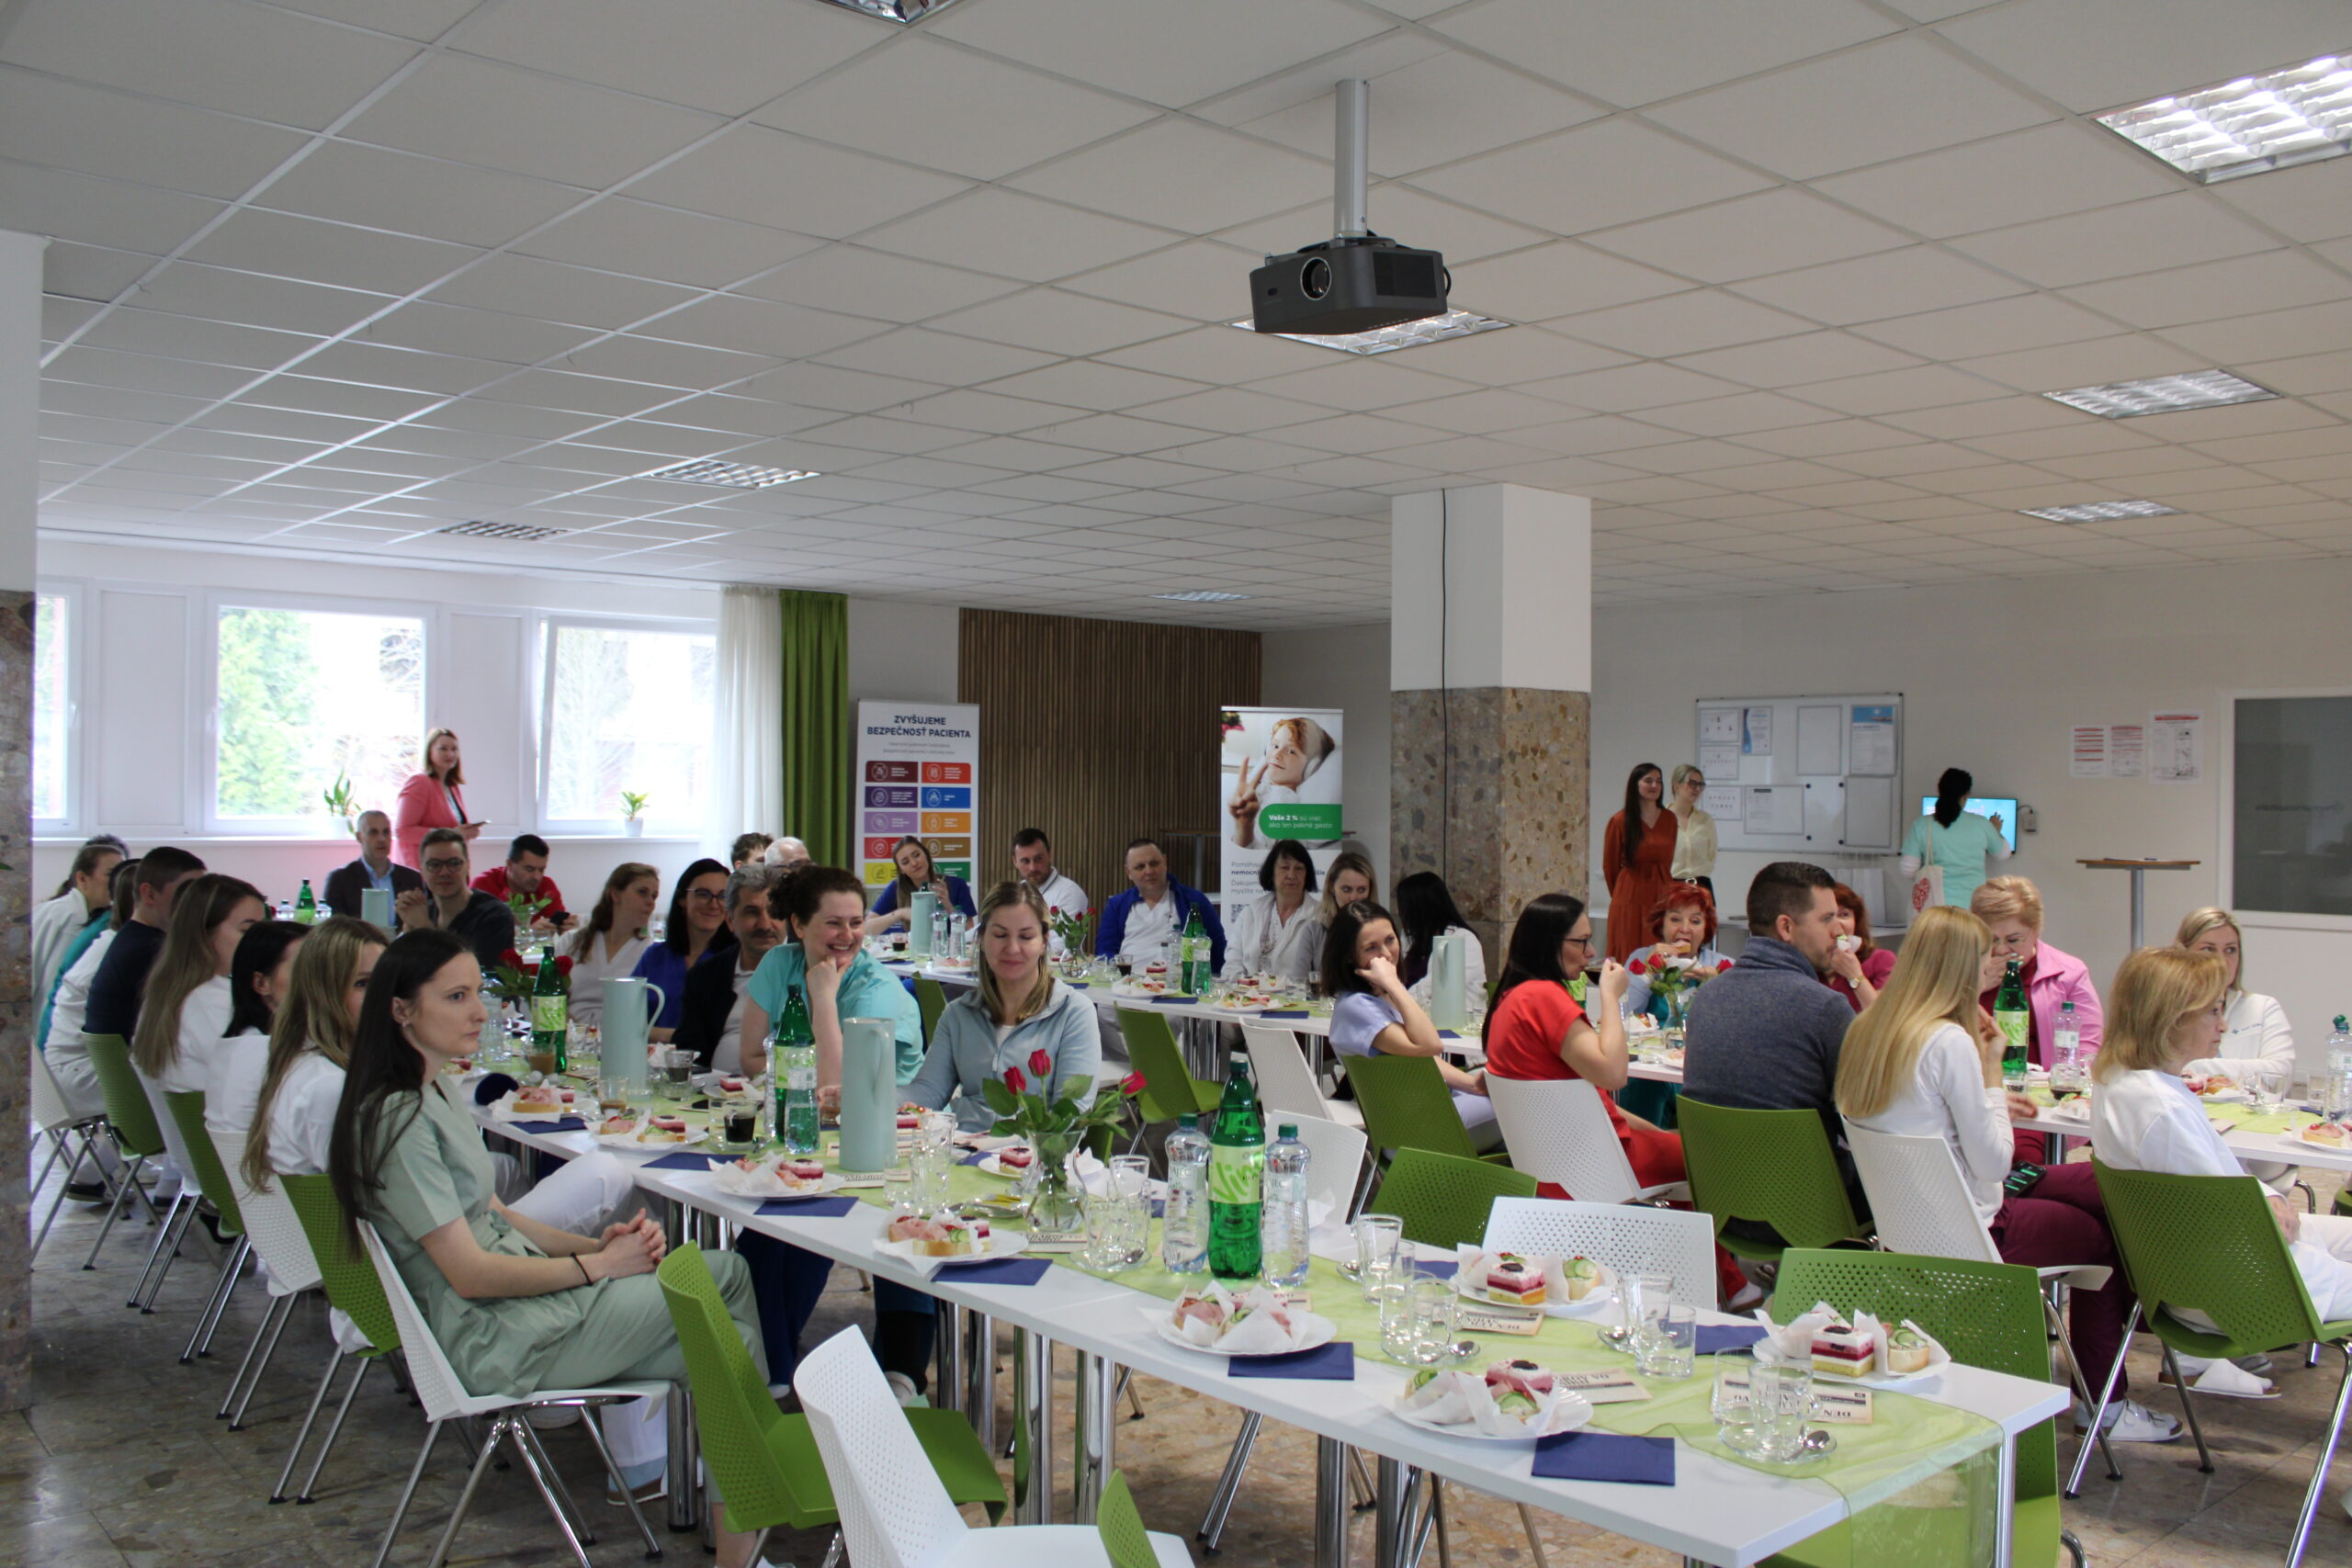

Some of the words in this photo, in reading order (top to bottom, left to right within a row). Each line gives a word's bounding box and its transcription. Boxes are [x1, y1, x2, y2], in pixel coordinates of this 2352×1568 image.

[894, 715, 946, 726] ZVYŠUJEME
[867, 726, 926, 737] BEZPEČNOSŤ
[929, 728, 971, 739] PACIENTA
